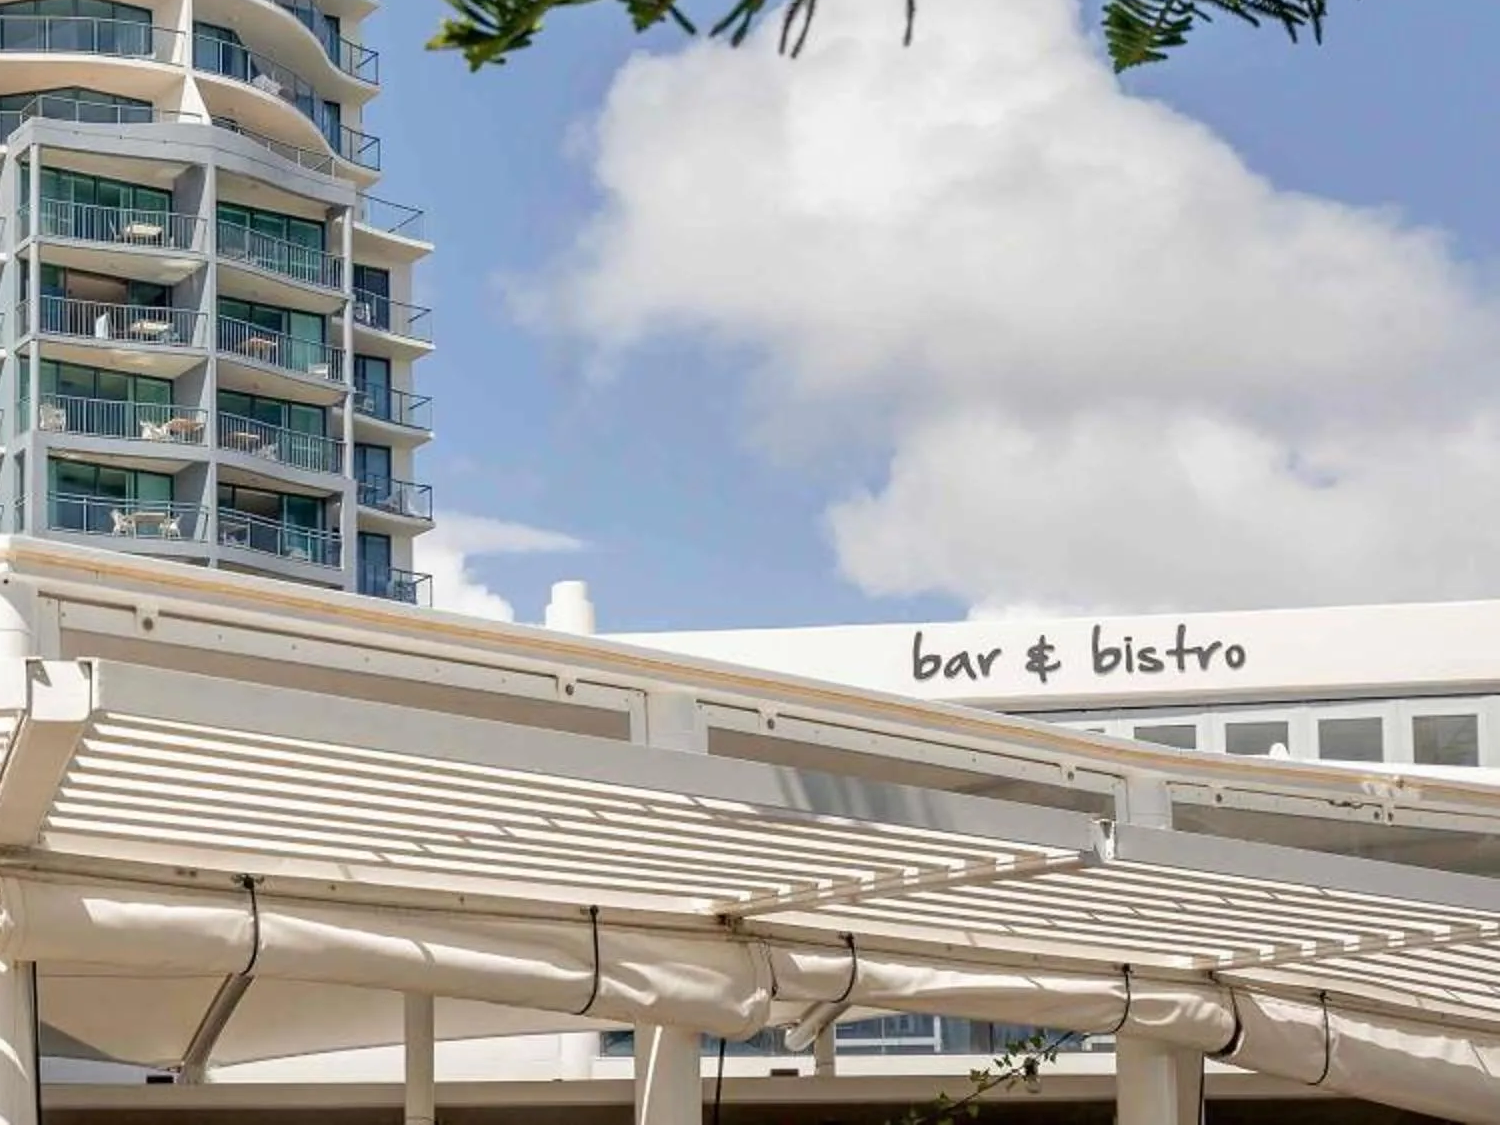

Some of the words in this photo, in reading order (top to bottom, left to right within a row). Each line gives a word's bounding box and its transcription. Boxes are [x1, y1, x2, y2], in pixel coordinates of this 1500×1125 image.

[912, 631, 1002, 681] bar
[1025, 634, 1062, 684] &
[1091, 624, 1246, 675] bistro
